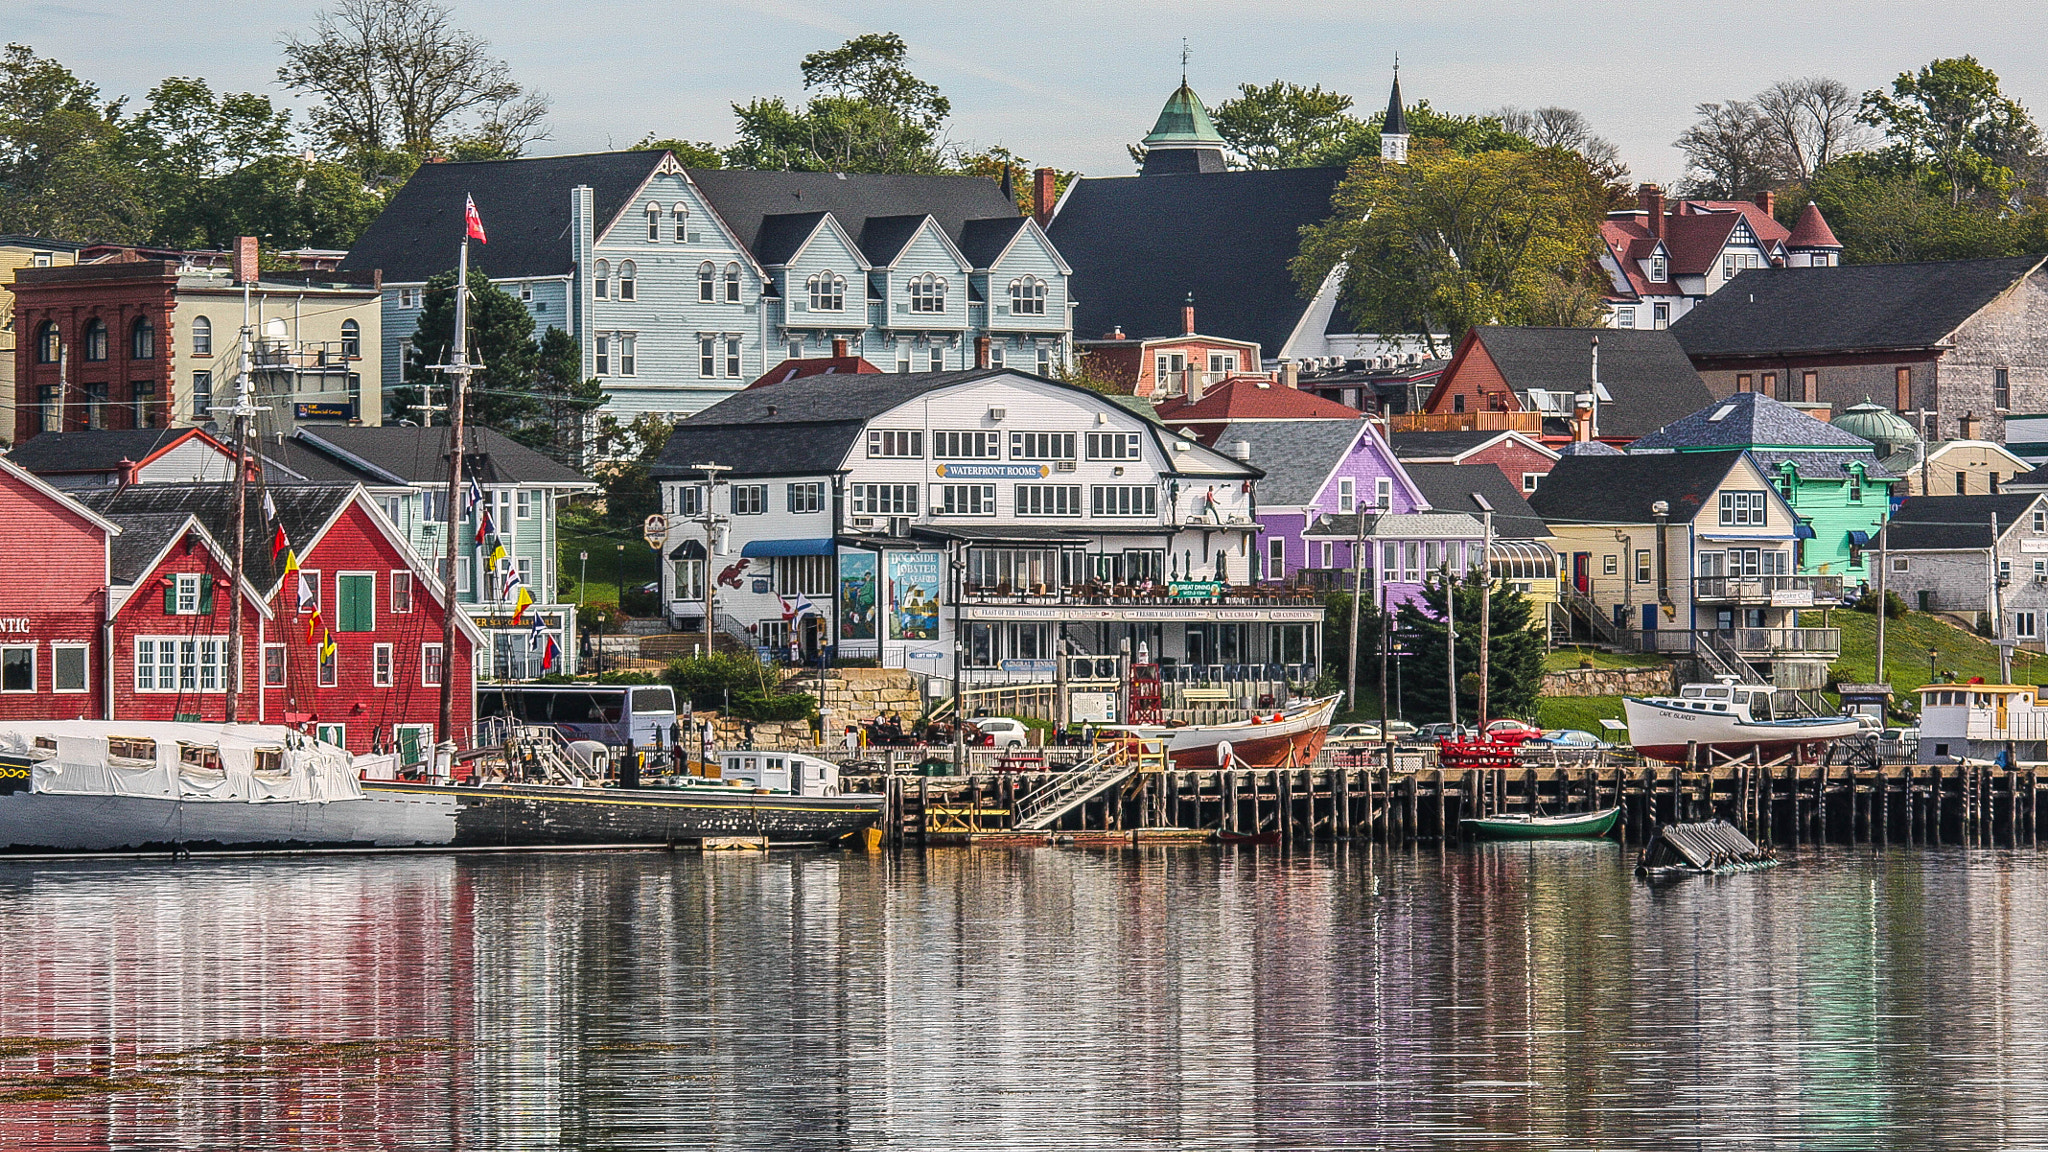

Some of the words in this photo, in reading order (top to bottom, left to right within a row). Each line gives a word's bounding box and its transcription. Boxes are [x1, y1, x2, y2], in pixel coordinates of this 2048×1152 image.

[950, 466, 1005, 476] WATERFRONT
[1007, 467, 1037, 476] ROOMS
[891, 553, 937, 564] DOCKSIDE
[897, 563, 937, 577] LOBSTER
[473, 617, 488, 627] ER
[1659, 710, 1673, 718] CAPE
[1673, 712, 1697, 721] ISLANDER
